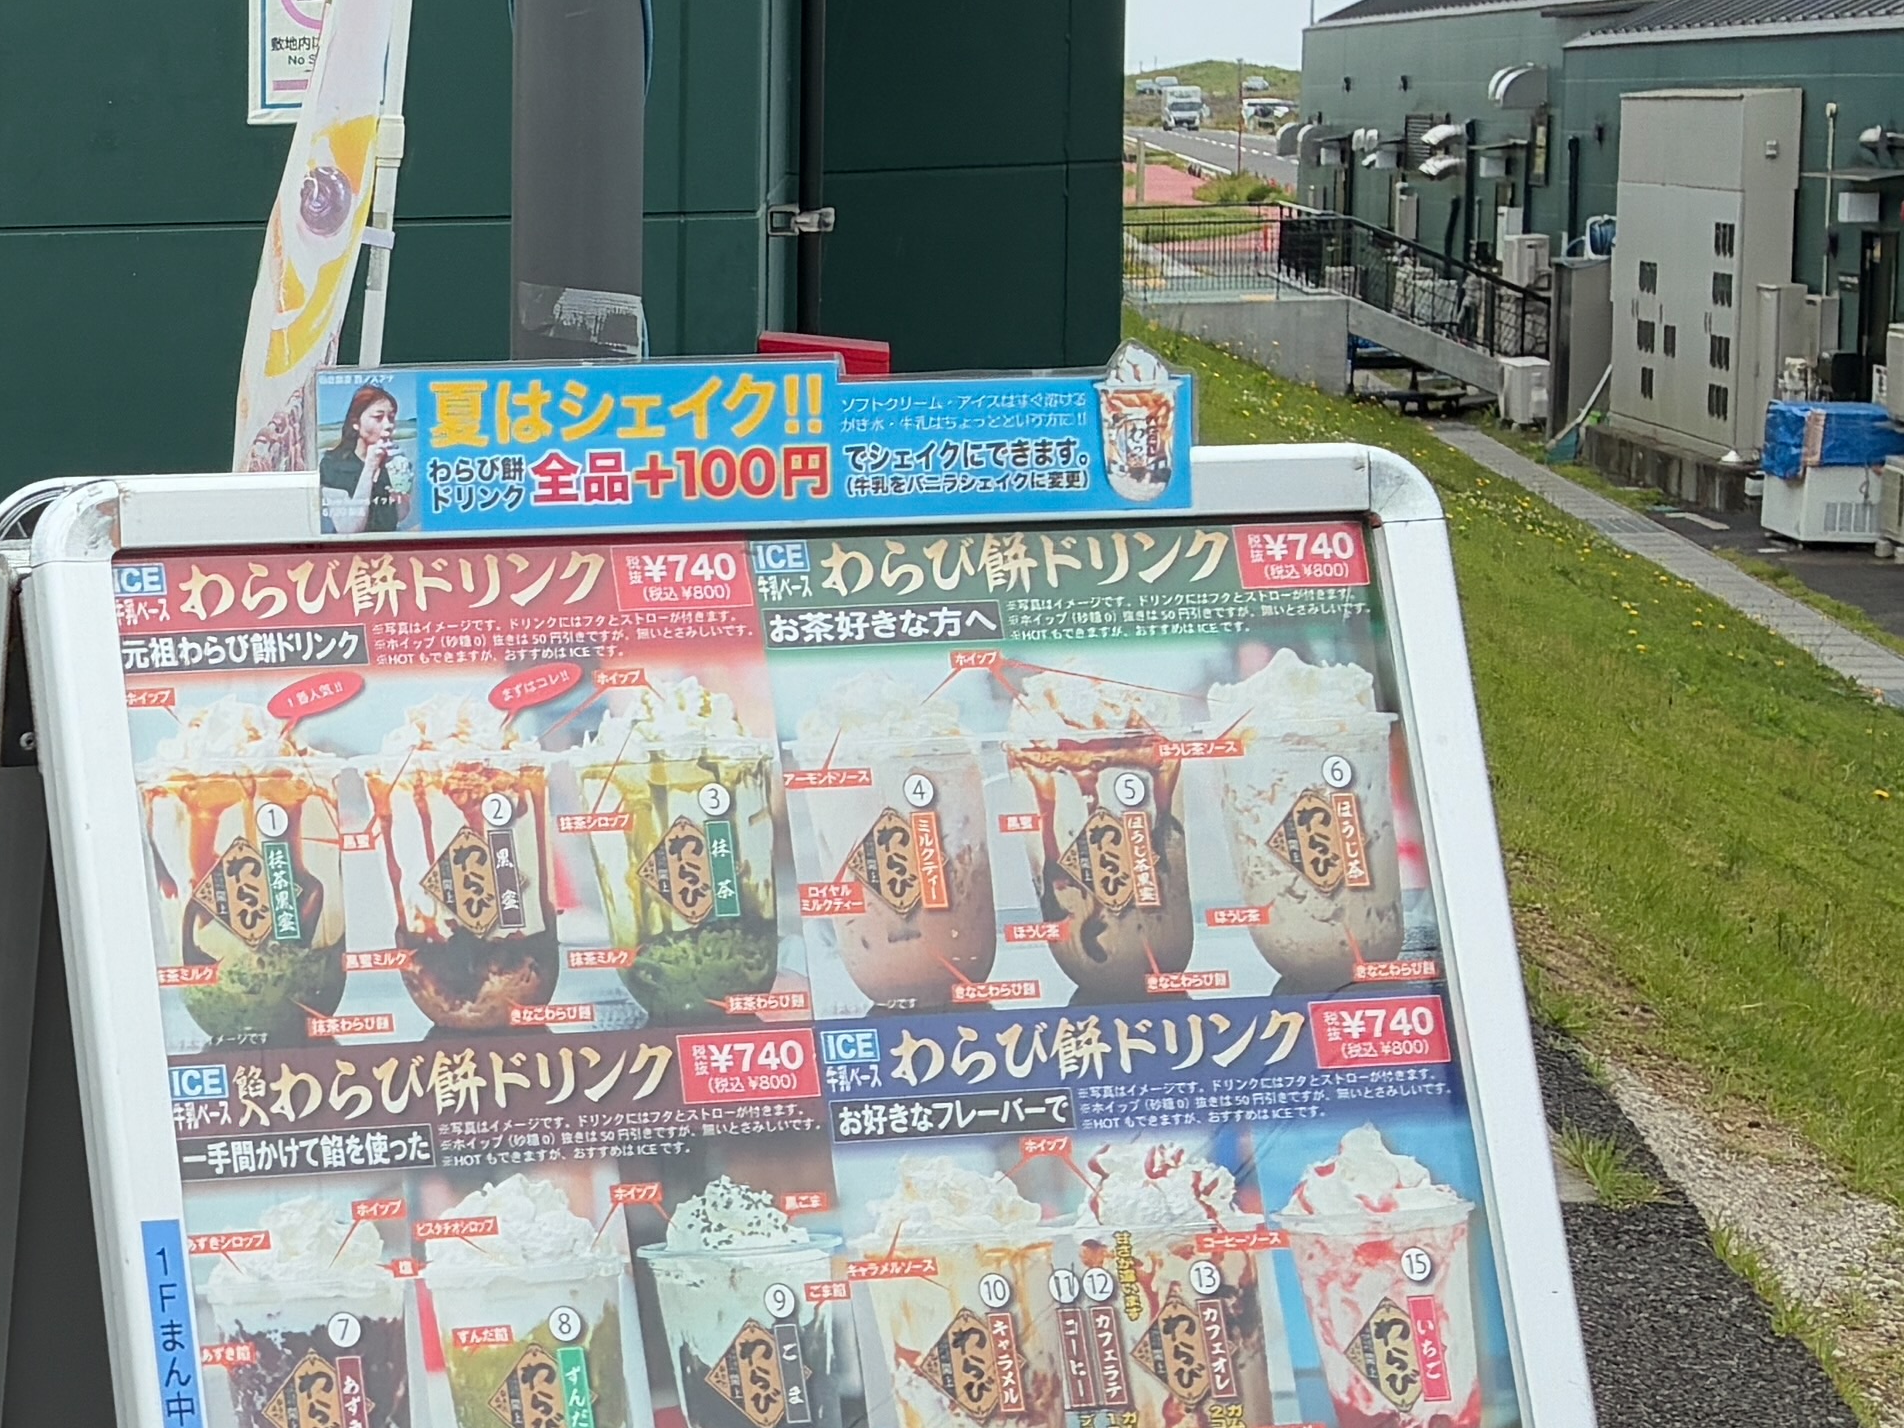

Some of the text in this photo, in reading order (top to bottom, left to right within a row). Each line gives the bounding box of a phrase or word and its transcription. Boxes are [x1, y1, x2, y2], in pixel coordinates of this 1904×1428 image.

[288, 56, 305, 64] No
[429, 457, 525, 485] わらび餅
[845, 438, 1091, 471] でシェイクにできます。
[530, 443, 830, 506] 全品+100円
[432, 485, 525, 513] ドリンク
[821, 529, 1231, 595] わらび餅ドリンク
[1265, 532, 1355, 561] ¥740
[179, 551, 606, 621] わらび餅ドリンク
[645, 552, 738, 584] ¥740
[769, 611, 999, 642] お茶好きな方へ
[122, 633, 360, 669] 元祖わらび餅ドリンク
[1342, 1007, 1435, 1038] ¥740
[709, 1039, 805, 1072] ¥740
[826, 1009, 1305, 1086] ICE わらび餅ドリンク
[172, 1068, 224, 1097] ICE
[269, 1043, 673, 1123] わらび餅ドリンク
[838, 1098, 1069, 1136] お好きなフレーバーで
[181, 1132, 431, 1177] 一手間かけて餡を使った
[991, 1316, 1018, 1406] キャラメル
[1202, 1306, 1230, 1393] カフェオレ
[1417, 1318, 1444, 1380] いちご
